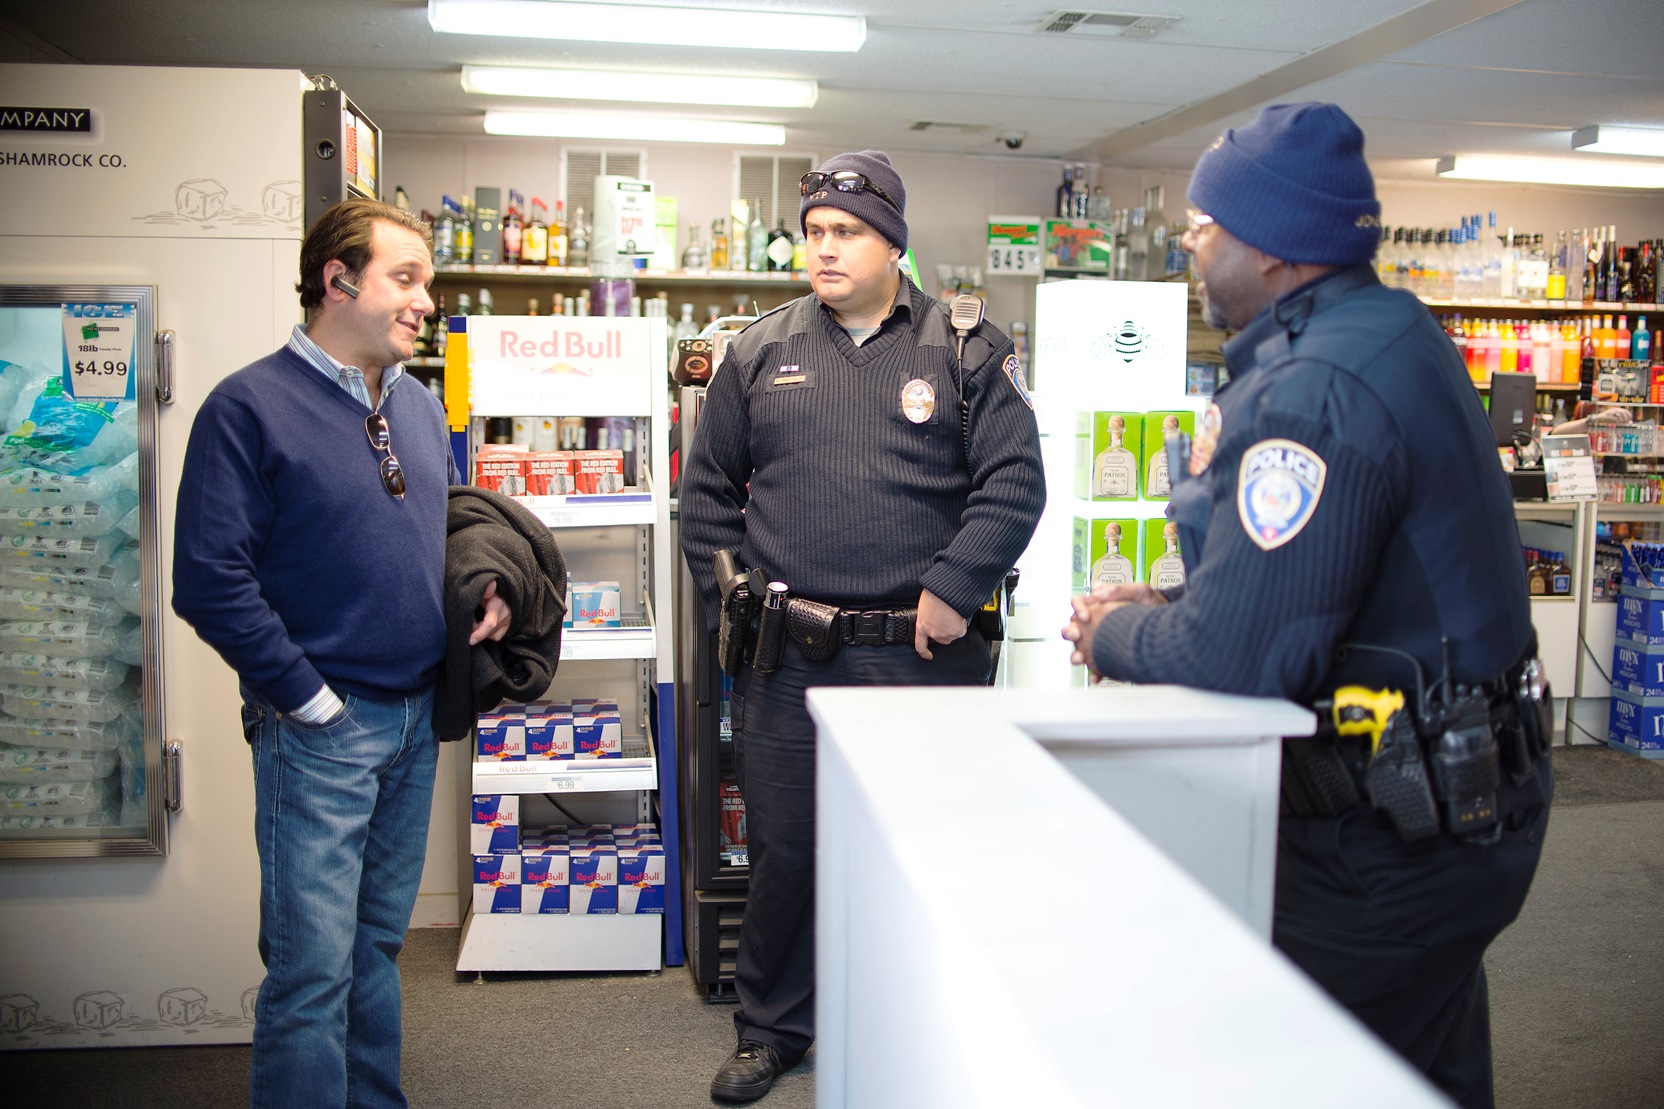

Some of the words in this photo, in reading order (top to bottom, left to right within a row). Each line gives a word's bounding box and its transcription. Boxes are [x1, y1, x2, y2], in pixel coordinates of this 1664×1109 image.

[0, 152, 93, 168] SHAMROCK
[99, 154, 127, 168] CO.
[74, 304, 124, 318] ICE
[500, 330, 558, 358] Red
[566, 330, 621, 358] Bull
[75, 360, 127, 376] $4.99
[1246, 448, 1320, 489] POLICE
[484, 743, 503, 751] Red
[504, 743, 520, 751] Bull
[532, 742, 551, 751] Red
[551, 741, 568, 749] Bull
[581, 740, 599, 749] Red
[599, 740, 616, 748] Bull
[499, 764, 517, 772] Red
[519, 764, 537, 772] Bull
[477, 812, 495, 820] Red
[496, 812, 512, 821] Bull
[480, 872, 498, 880] Red
[498, 871, 515, 880] Bull
[528, 872, 546, 881] Red
[547, 872, 564, 880] Bull
[576, 872, 594, 881] Red
[595, 873, 611, 881] Bull
[624, 872, 642, 881] Red
